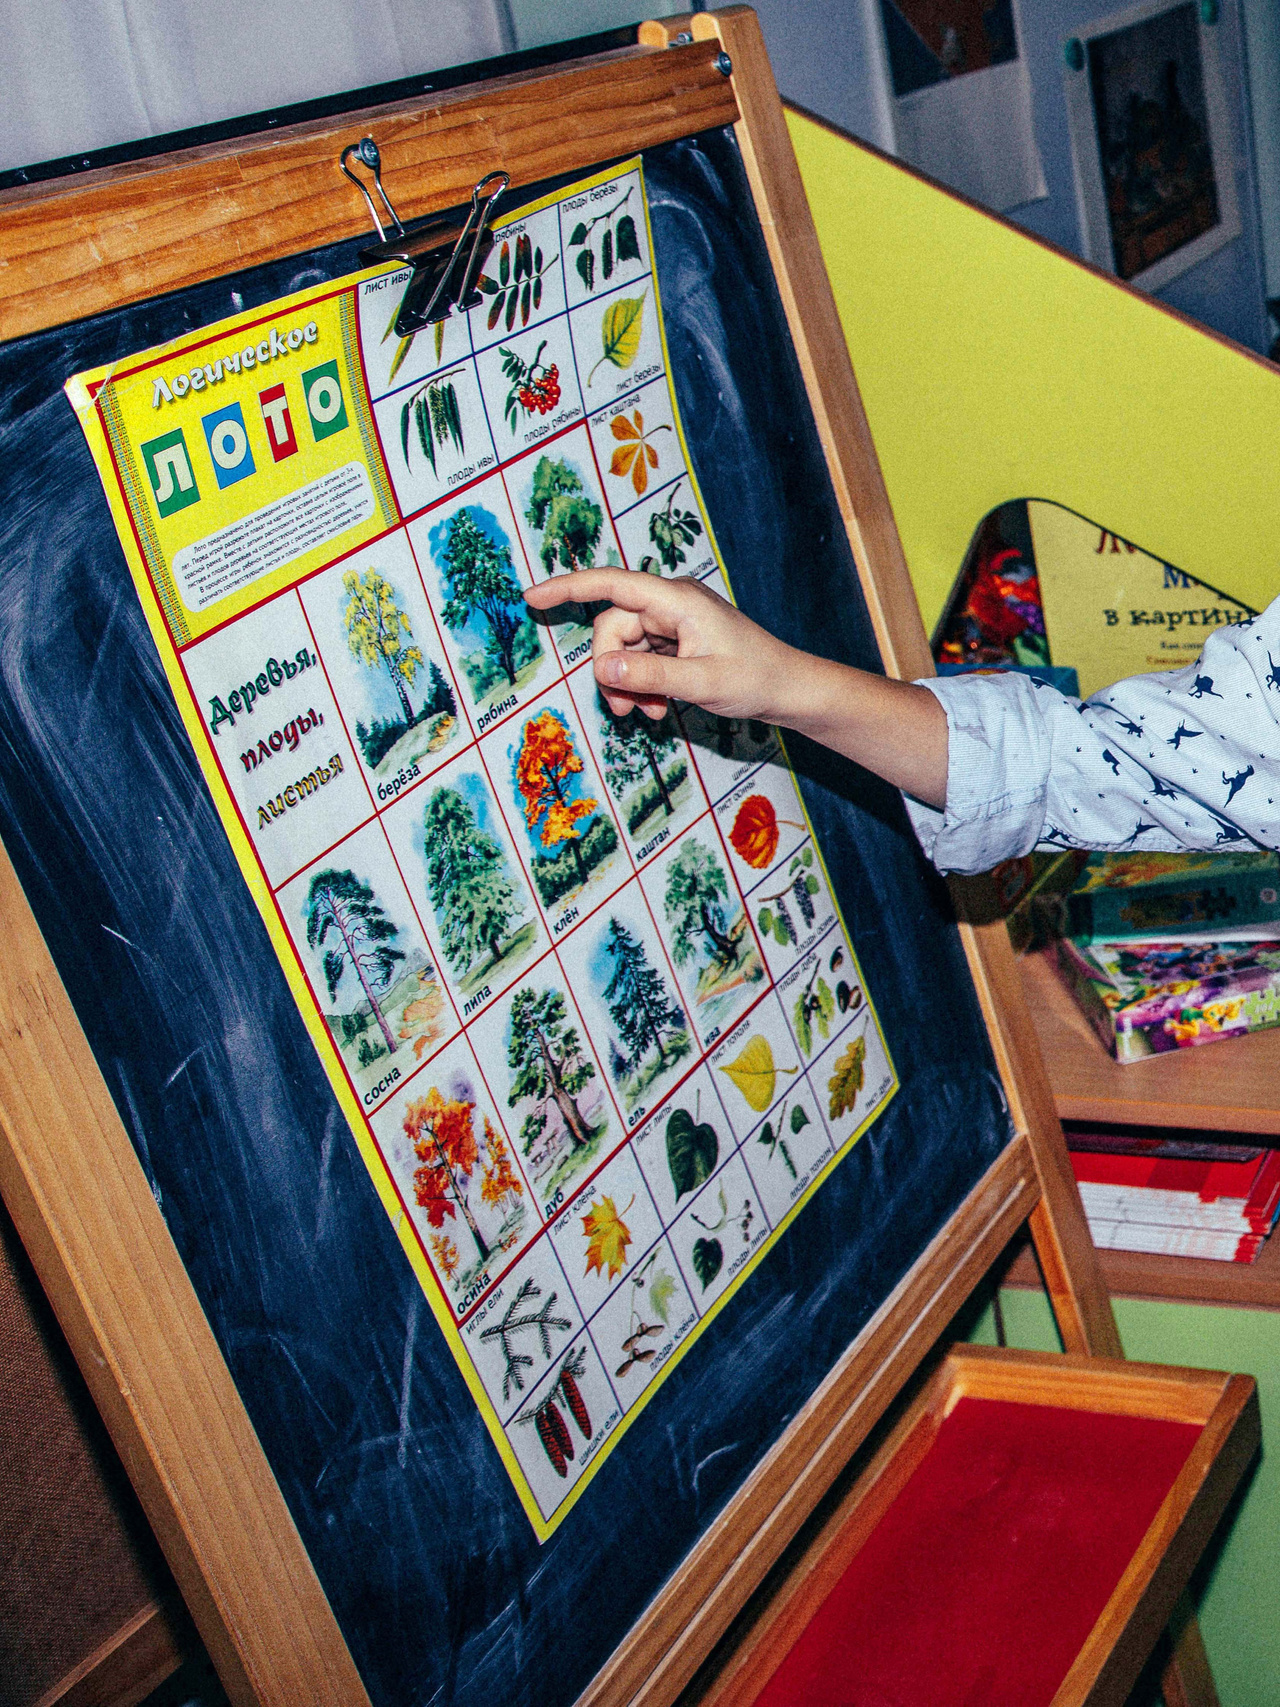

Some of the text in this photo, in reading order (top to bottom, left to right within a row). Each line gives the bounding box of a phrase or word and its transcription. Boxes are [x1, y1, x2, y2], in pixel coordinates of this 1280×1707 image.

[562, 184, 618, 213] плоды берёзы
[494, 222, 527, 245] рябины
[364, 270, 412, 295] лист ивы
[152, 321, 318, 409] Логическое
[616, 363, 662, 394] лист берёзы
[524, 406, 582, 443] плоды рябины
[591, 395, 641, 428] лист каштана
[152, 375, 343, 503] ЛОТО
[447, 454, 495, 486] плоды ивы
[1103, 608, 1252, 632] в картин
[209, 647, 318, 735] Деревья,
[476, 693, 519, 733] рябина
[240, 708, 325, 773] плоды,
[258, 753, 345, 830] листья
[377, 764, 422, 801] берёза
[636, 826, 671, 862] каштан
[553, 907, 580, 935] клён
[462, 985, 493, 1016] липа
[704, 1026, 721, 1047] ива
[364, 1067, 401, 1105] сосна
[628, 1106, 646, 1126] ель
[636, 1104, 673, 1145] лист липы
[545, 1187, 565, 1219] дуб
[554, 1214, 573, 1235] лист
[456, 1273, 492, 1316] осина
[465, 1288, 505, 1335] иглы ели
[650, 1340, 675, 1371] плоды
[578, 1409, 620, 1466] шишки ели
